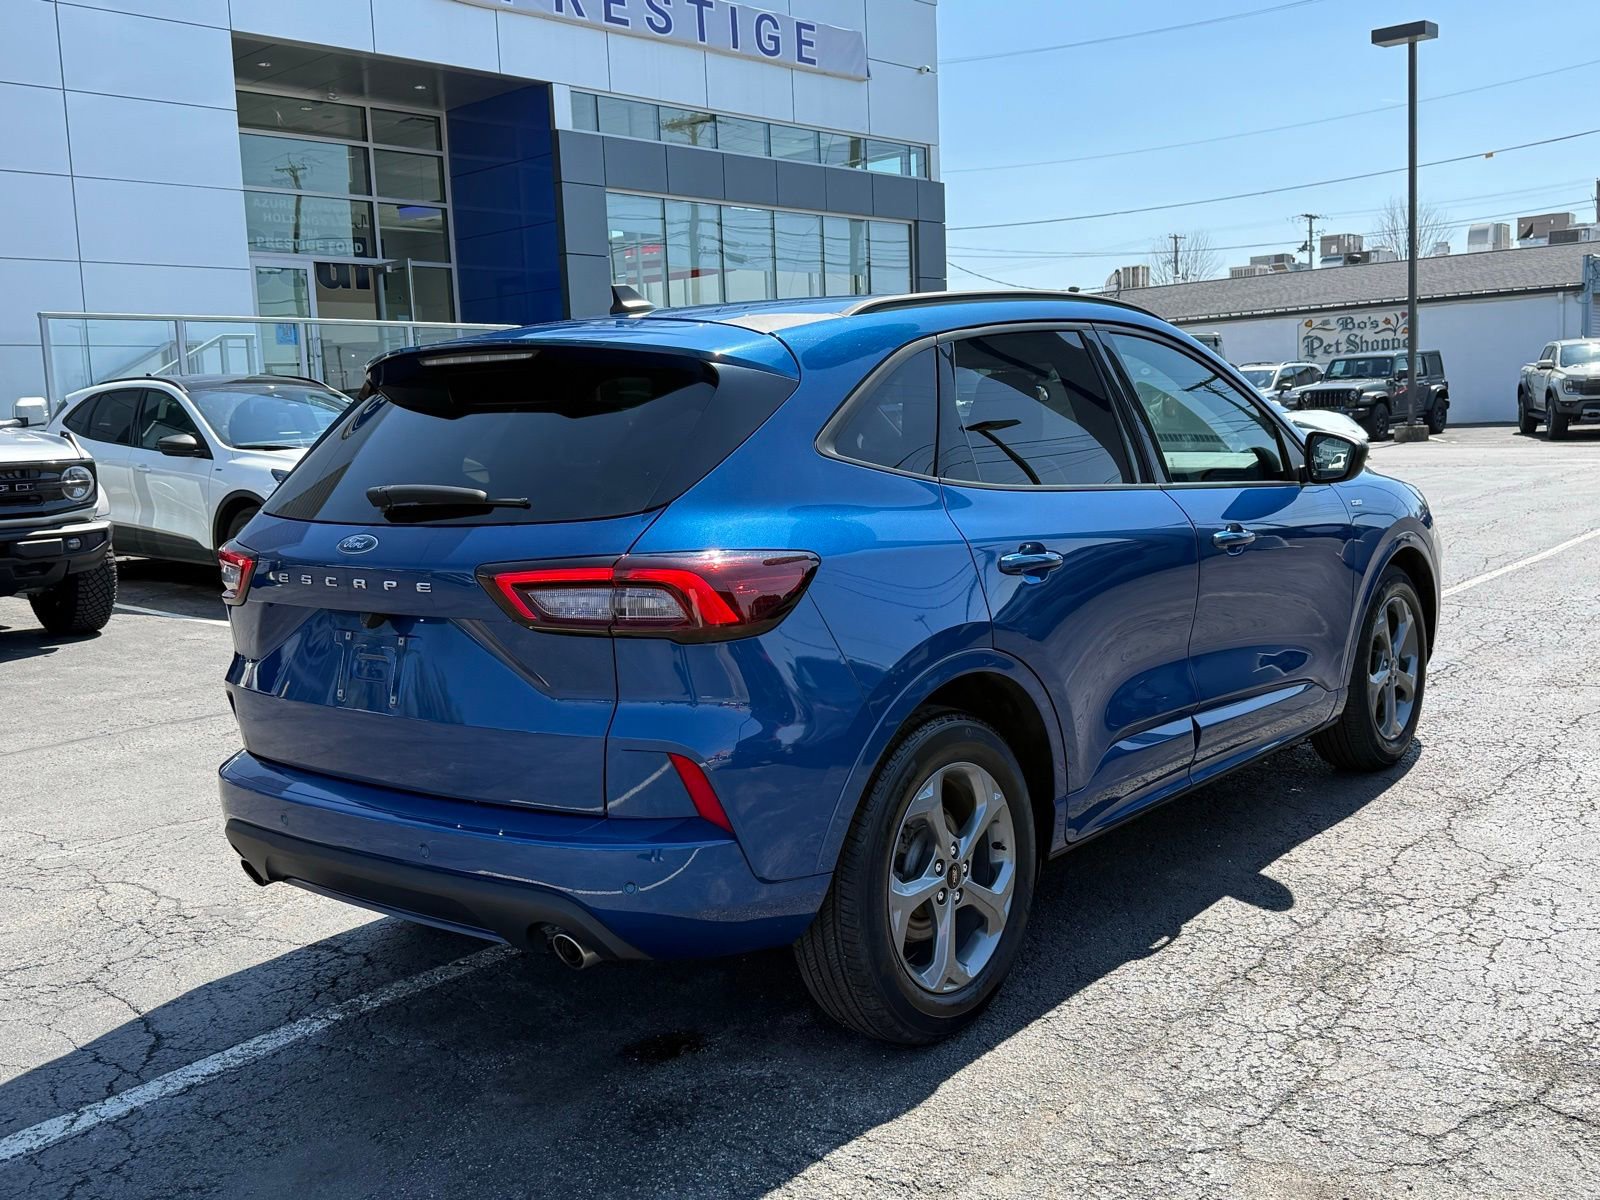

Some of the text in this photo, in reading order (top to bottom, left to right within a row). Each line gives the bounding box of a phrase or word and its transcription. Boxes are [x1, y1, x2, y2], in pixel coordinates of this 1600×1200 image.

[503, 0, 817, 66] ESTIGE
[264, 212, 328, 226] HOLDNGS
[1336, 315, 1380, 333] Bo's
[1303, 335, 1342, 358] Pet
[342, 535, 370, 550] Ford
[278, 572, 432, 593] ESCAPE
